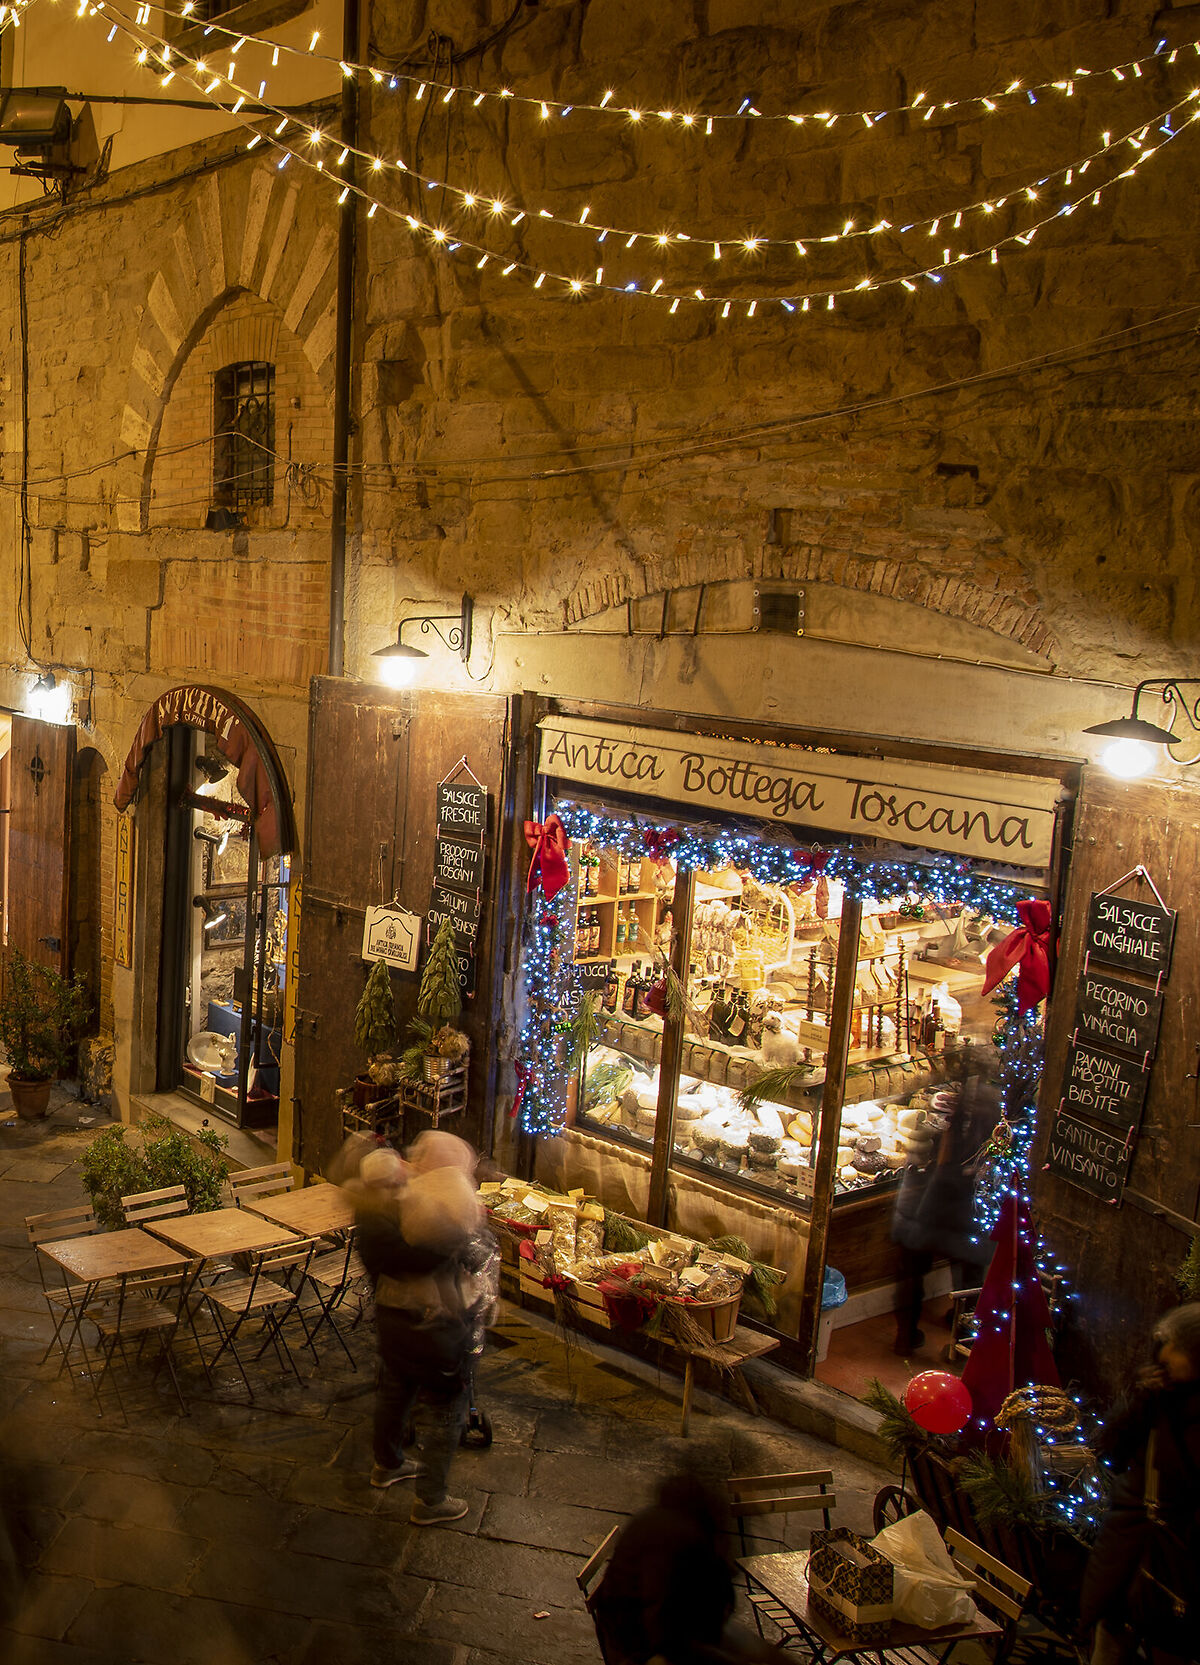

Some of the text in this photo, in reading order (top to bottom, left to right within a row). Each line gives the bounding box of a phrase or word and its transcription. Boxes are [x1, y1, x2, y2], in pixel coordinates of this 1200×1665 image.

[442, 788, 480, 808] SALSICCE
[547, 732, 1034, 849] Antica Bottega Toscana
[440, 806, 481, 826] FRESCHE
[439, 841, 478, 863] PRODOTTI
[442, 854, 464, 868] TIPICI
[437, 864, 474, 883] TOSCANI
[118, 822, 128, 961] ANTICHIA
[437, 890, 468, 913] SALUMI
[451, 916, 478, 937] SENESE
[1097, 901, 1161, 934] SALSICCE
[1118, 926, 1126, 935] DI
[1093, 930, 1160, 961] CINGHIALE
[1086, 981, 1148, 1017] PECORINO
[1100, 1005, 1123, 1020] ALLA
[1082, 1013, 1138, 1047] VINACCIA
[1075, 1050, 1121, 1079] PANINI
[1071, 1065, 1131, 1098] IMBOTTITI
[1068, 1084, 1121, 1115] BIBITE
[1052, 1142, 1118, 1188] VINSANTO
